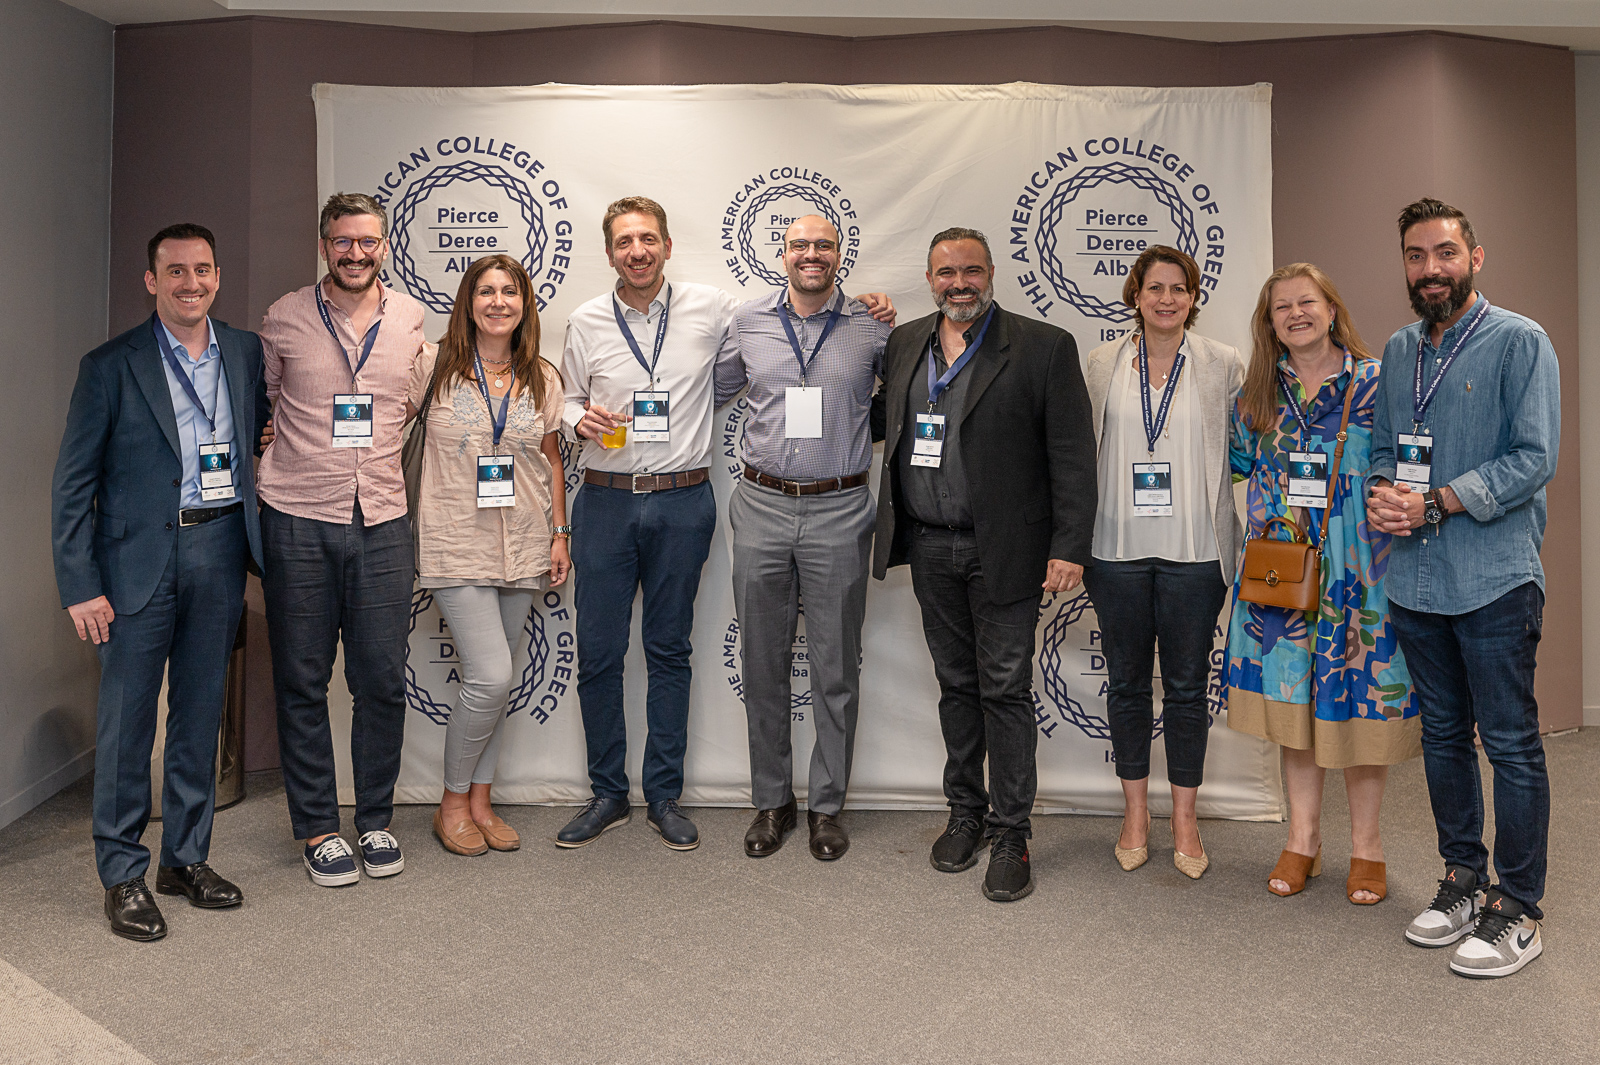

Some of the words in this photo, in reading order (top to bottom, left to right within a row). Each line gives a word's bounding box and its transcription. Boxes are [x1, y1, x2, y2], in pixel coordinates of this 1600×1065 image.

[436, 136, 545, 179] COLLEGE
[541, 179, 569, 210] OF
[1084, 137, 1195, 183] COLLEGE
[769, 166, 842, 198] COLLEGE
[721, 174, 766, 252] AMERICAN
[839, 198, 857, 220] OF
[1009, 146, 1079, 263] AMERICAN
[1191, 183, 1219, 215] OF
[437, 207, 499, 223] Pierce
[770, 214, 800, 226] Pier
[1085, 208, 1148, 226] Pierce
[438, 232, 498, 248] Deree
[1086, 234, 1147, 251] Deree
[726, 256, 750, 287] THE
[1093, 259, 1135, 276] Alb
[1197, 225, 1225, 306] GREEC
[1017, 270, 1054, 318] THE
[1100, 329, 1131, 341] 187
[723, 397, 749, 458] AMERIC
[728, 463, 744, 485] HE
[543, 590, 570, 621] OF
[723, 617, 739, 669] AMERI
[529, 631, 574, 725] GREECE
[792, 666, 808, 677] ba
[1207, 649, 1225, 728] GREE
[791, 712, 805, 721] 75
